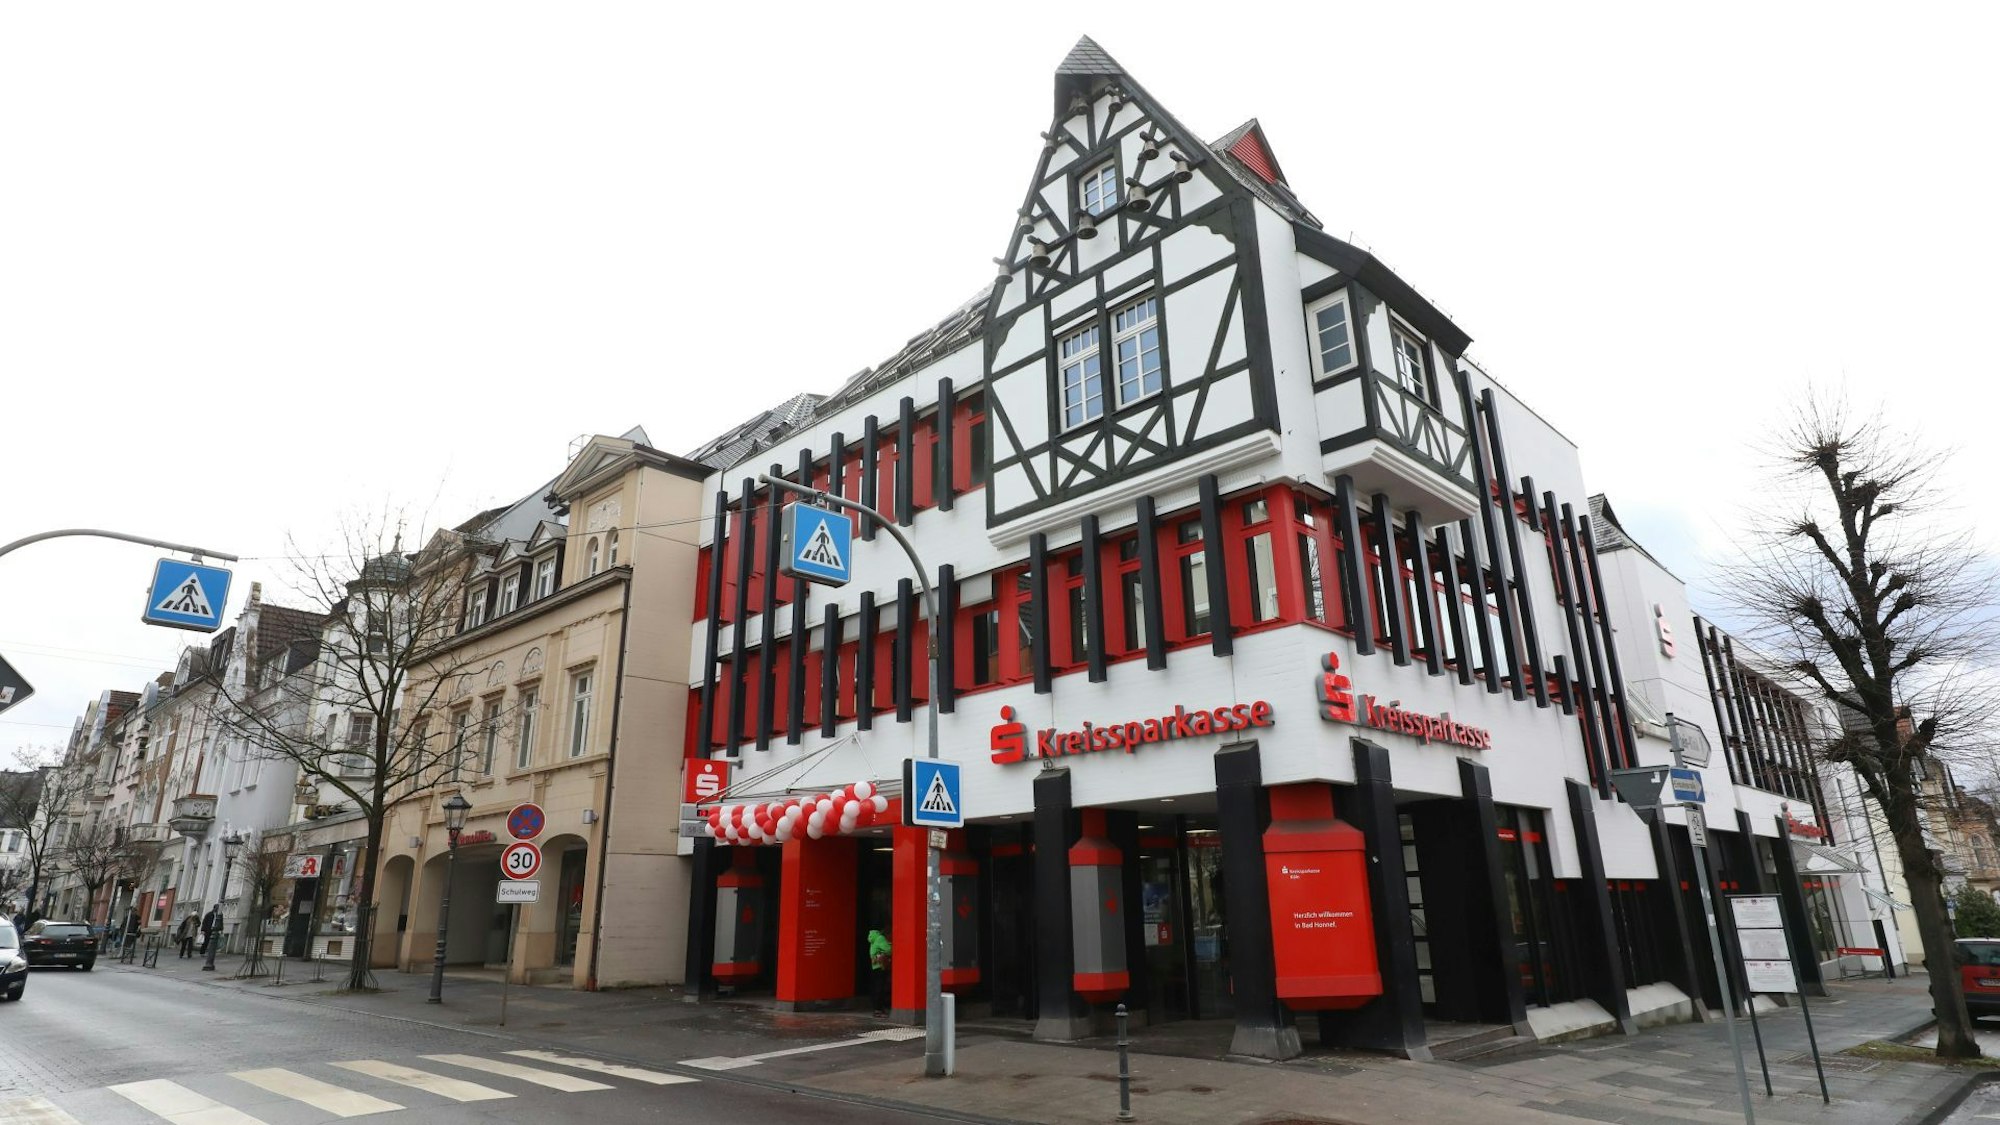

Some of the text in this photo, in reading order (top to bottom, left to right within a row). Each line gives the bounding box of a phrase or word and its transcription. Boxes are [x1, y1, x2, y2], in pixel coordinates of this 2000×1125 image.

[1037, 699, 1274, 758] Kreissparkasse
[1358, 694, 1492, 749] Kreissparkasse
[510, 852, 533, 869] 30
[501, 887, 537, 897] Schulweg
